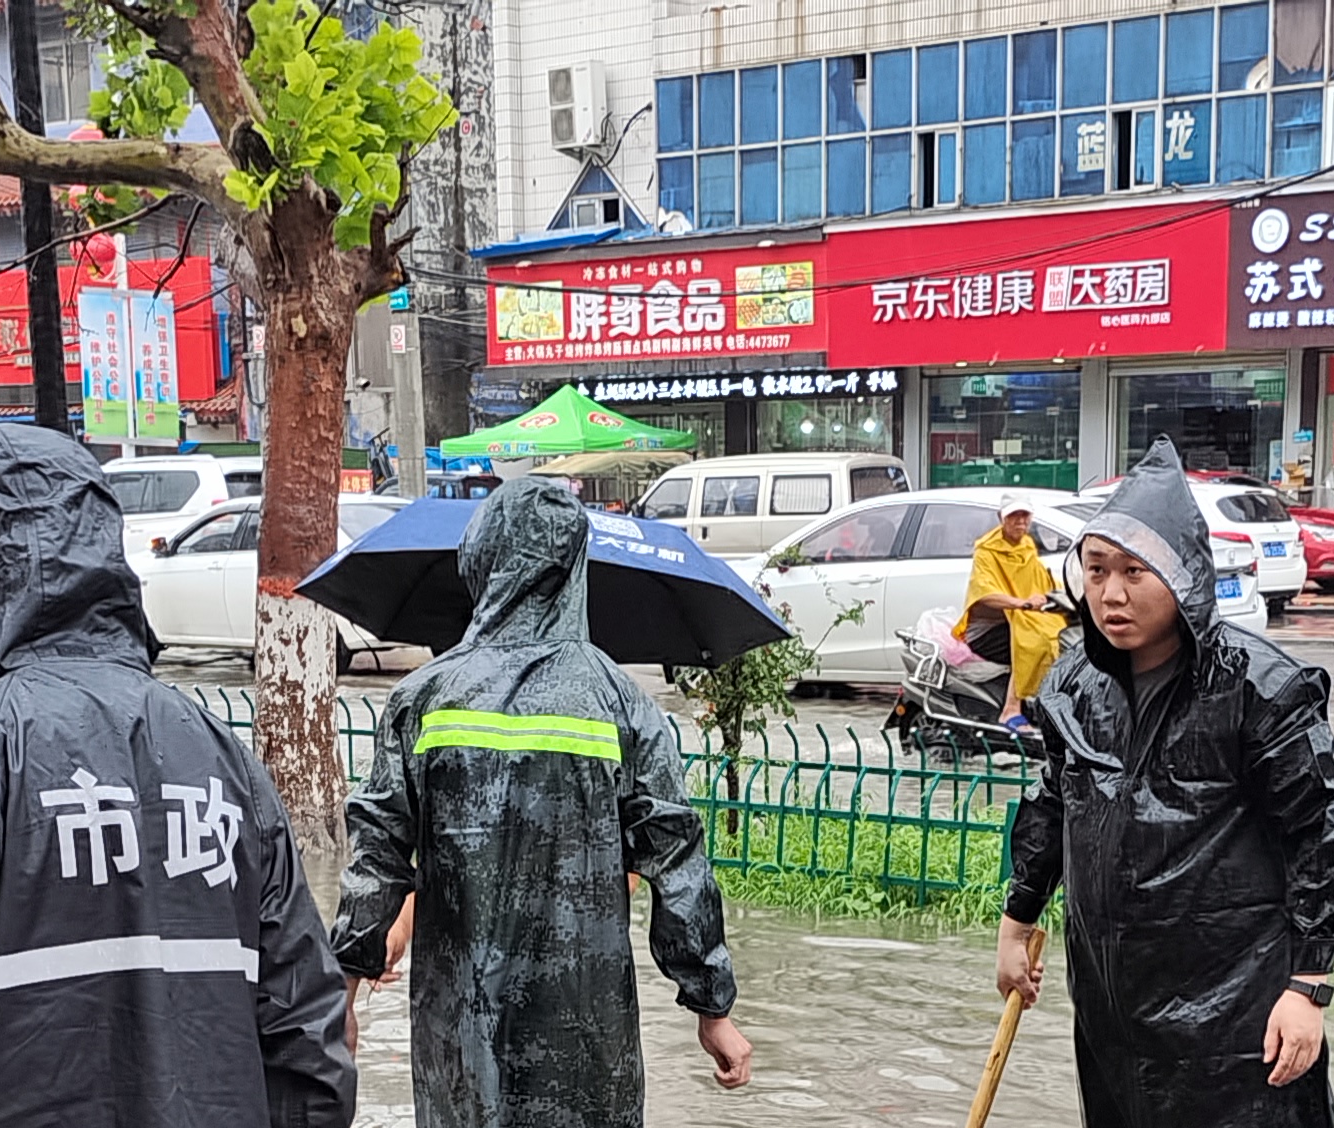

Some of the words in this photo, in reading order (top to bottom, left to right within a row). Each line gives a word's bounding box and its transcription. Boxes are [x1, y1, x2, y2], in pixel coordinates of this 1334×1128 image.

[582, 258, 703, 281] 冷冻食材一站式购物
[871, 270, 1036, 323] 京东健康
[1048, 270, 1065, 308] 联盟
[1071, 266, 1166, 306] 大药房
[568, 278, 726, 341] 胖哥食品
[90, 340, 104, 425] 维护公共卫生
[38, 766, 245, 892] 市政
